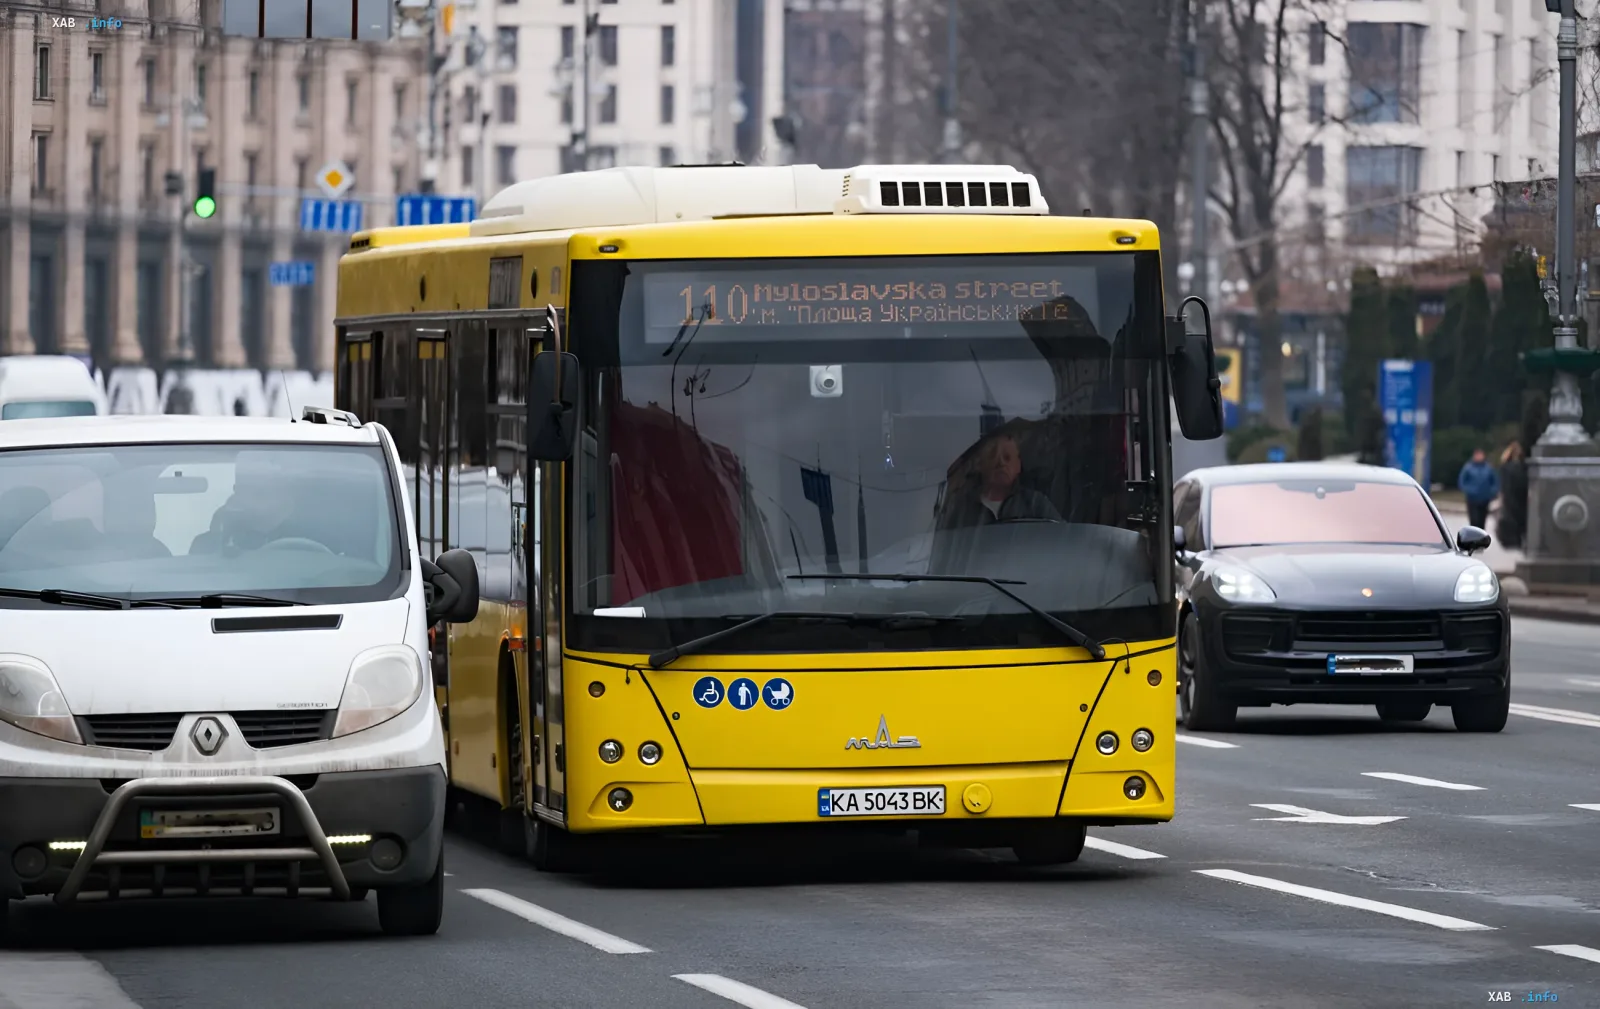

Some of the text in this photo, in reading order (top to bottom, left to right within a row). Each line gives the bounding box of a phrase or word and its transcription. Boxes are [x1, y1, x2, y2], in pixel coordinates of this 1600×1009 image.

[754, 280, 1065, 301] Myloslavska street
[679, 284, 748, 326] 110
[864, 791, 909, 811] 5043
